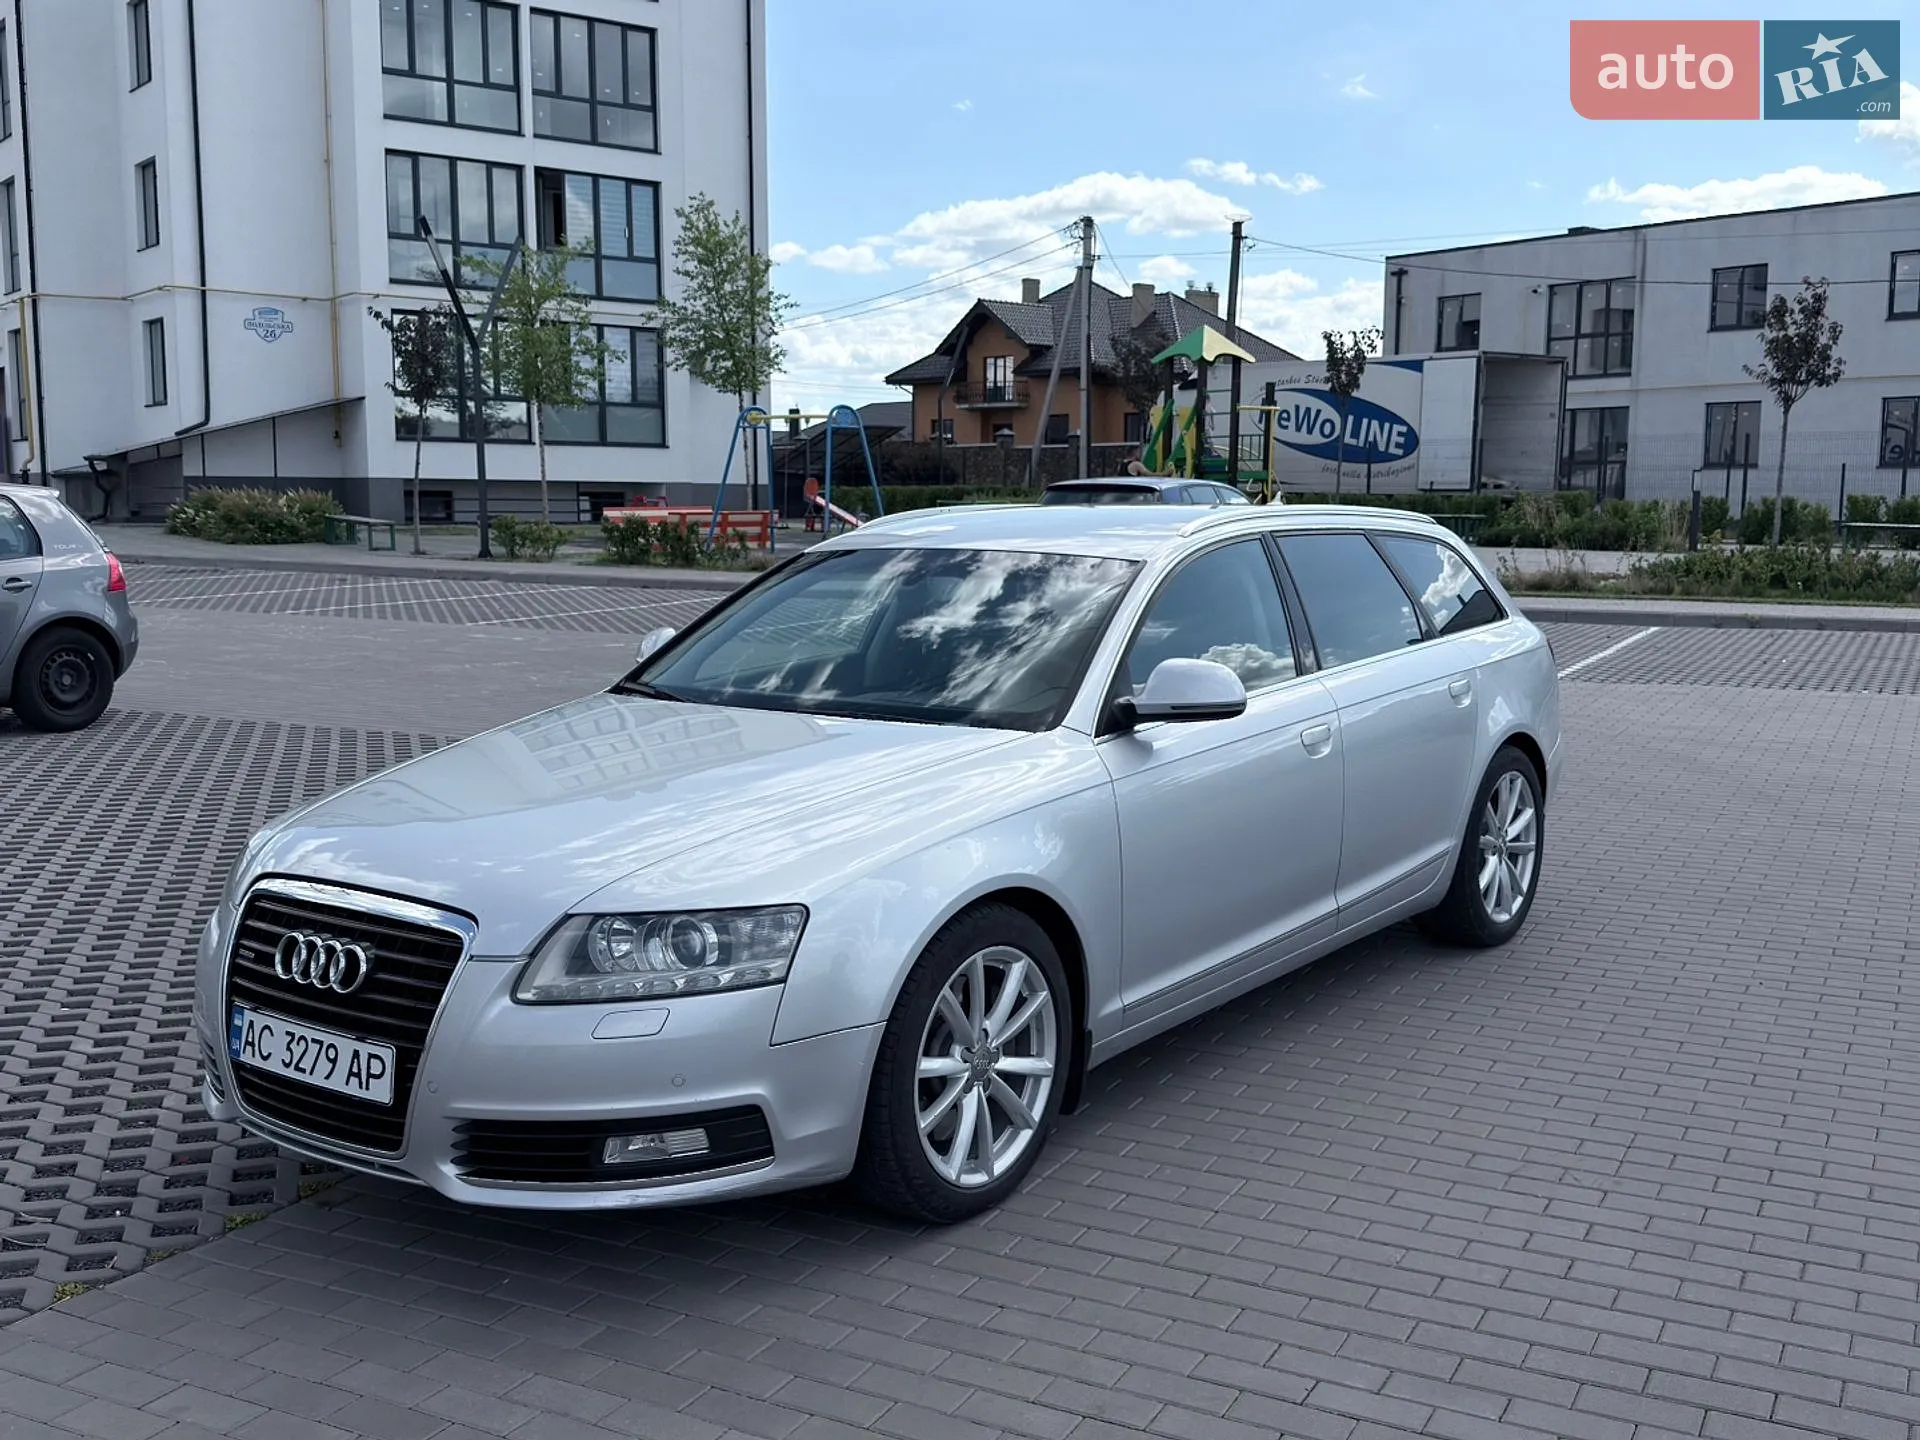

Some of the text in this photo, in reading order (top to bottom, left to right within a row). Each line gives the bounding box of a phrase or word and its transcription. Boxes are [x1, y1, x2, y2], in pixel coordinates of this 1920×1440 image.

[242, 1019, 386, 1091] AC 3279 AP
